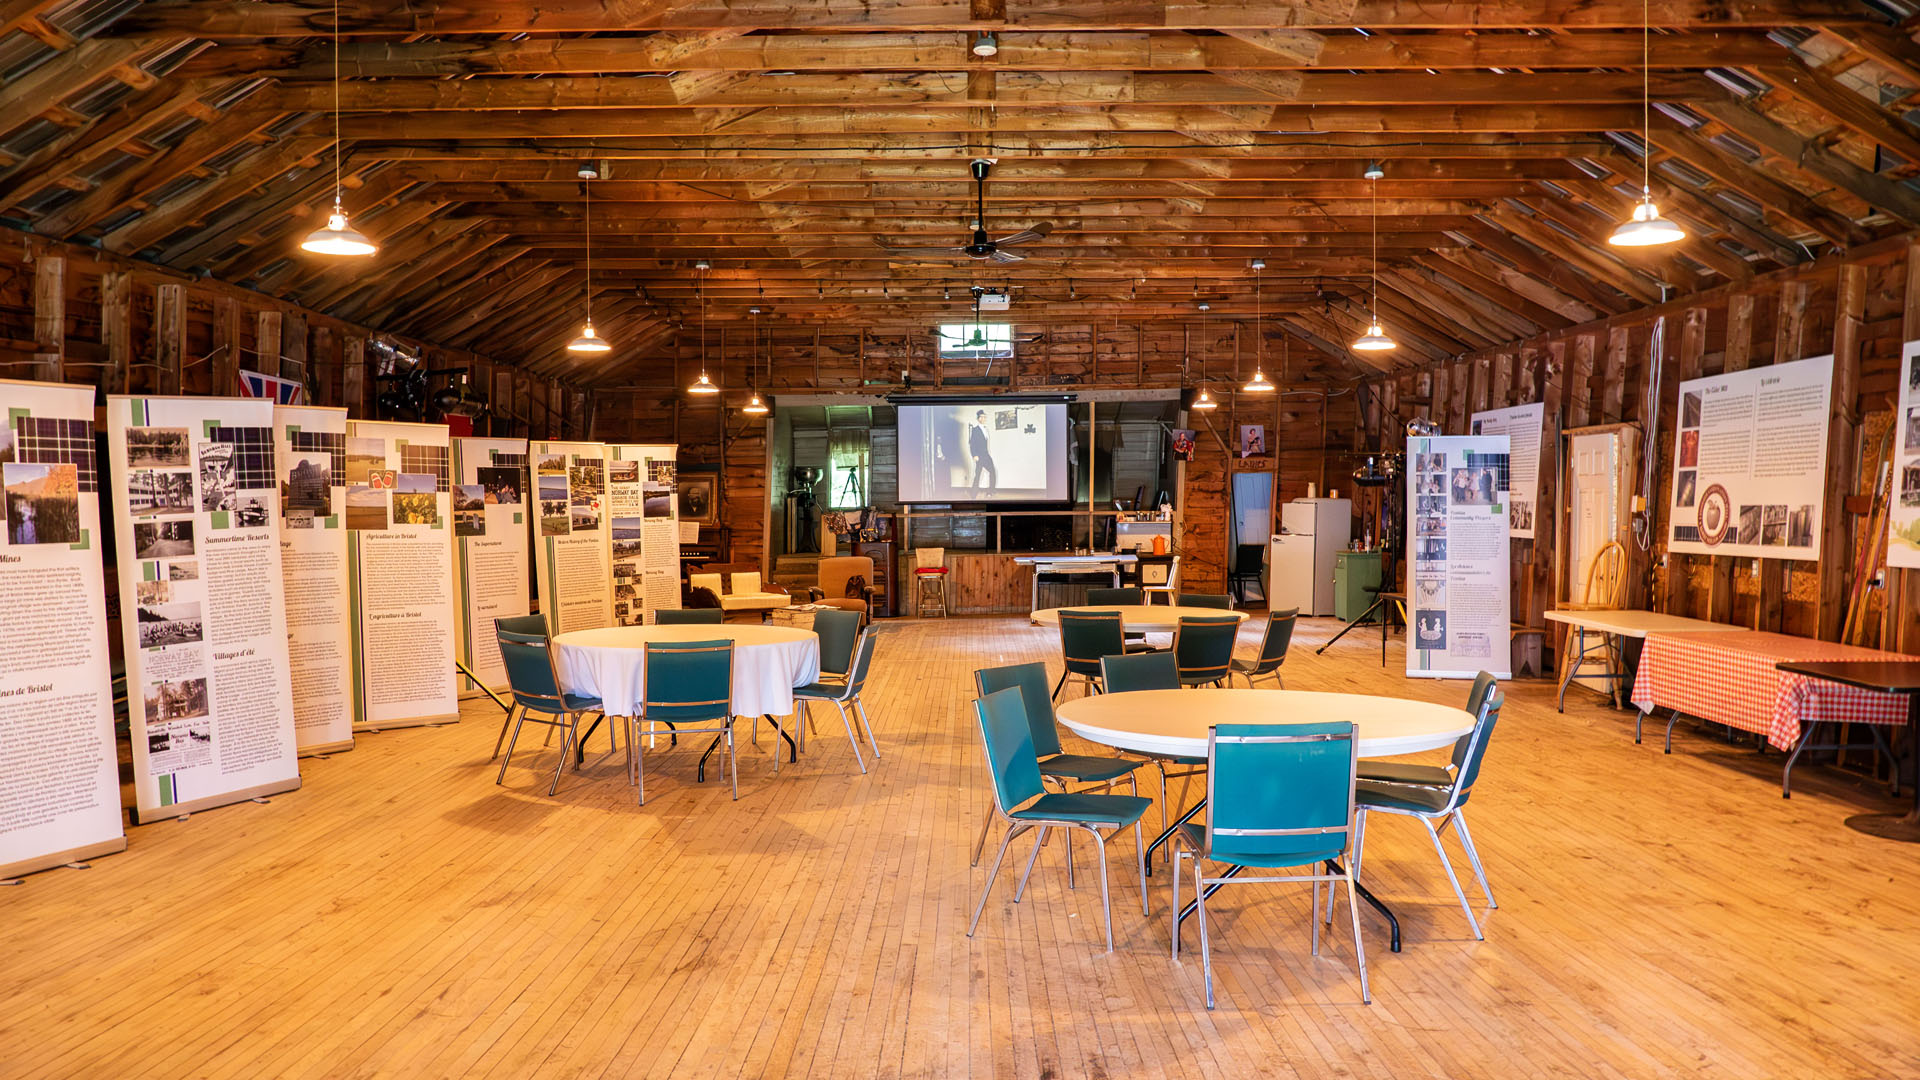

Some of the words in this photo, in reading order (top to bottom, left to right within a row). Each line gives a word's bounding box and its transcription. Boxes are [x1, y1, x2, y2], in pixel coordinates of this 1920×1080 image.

[205, 536, 245, 544] Summertime
[246, 533, 270, 541] Resorts
[212, 652, 240, 661] Villages
[16, 688, 26, 696] de
[27, 682, 53, 694] Bristol
